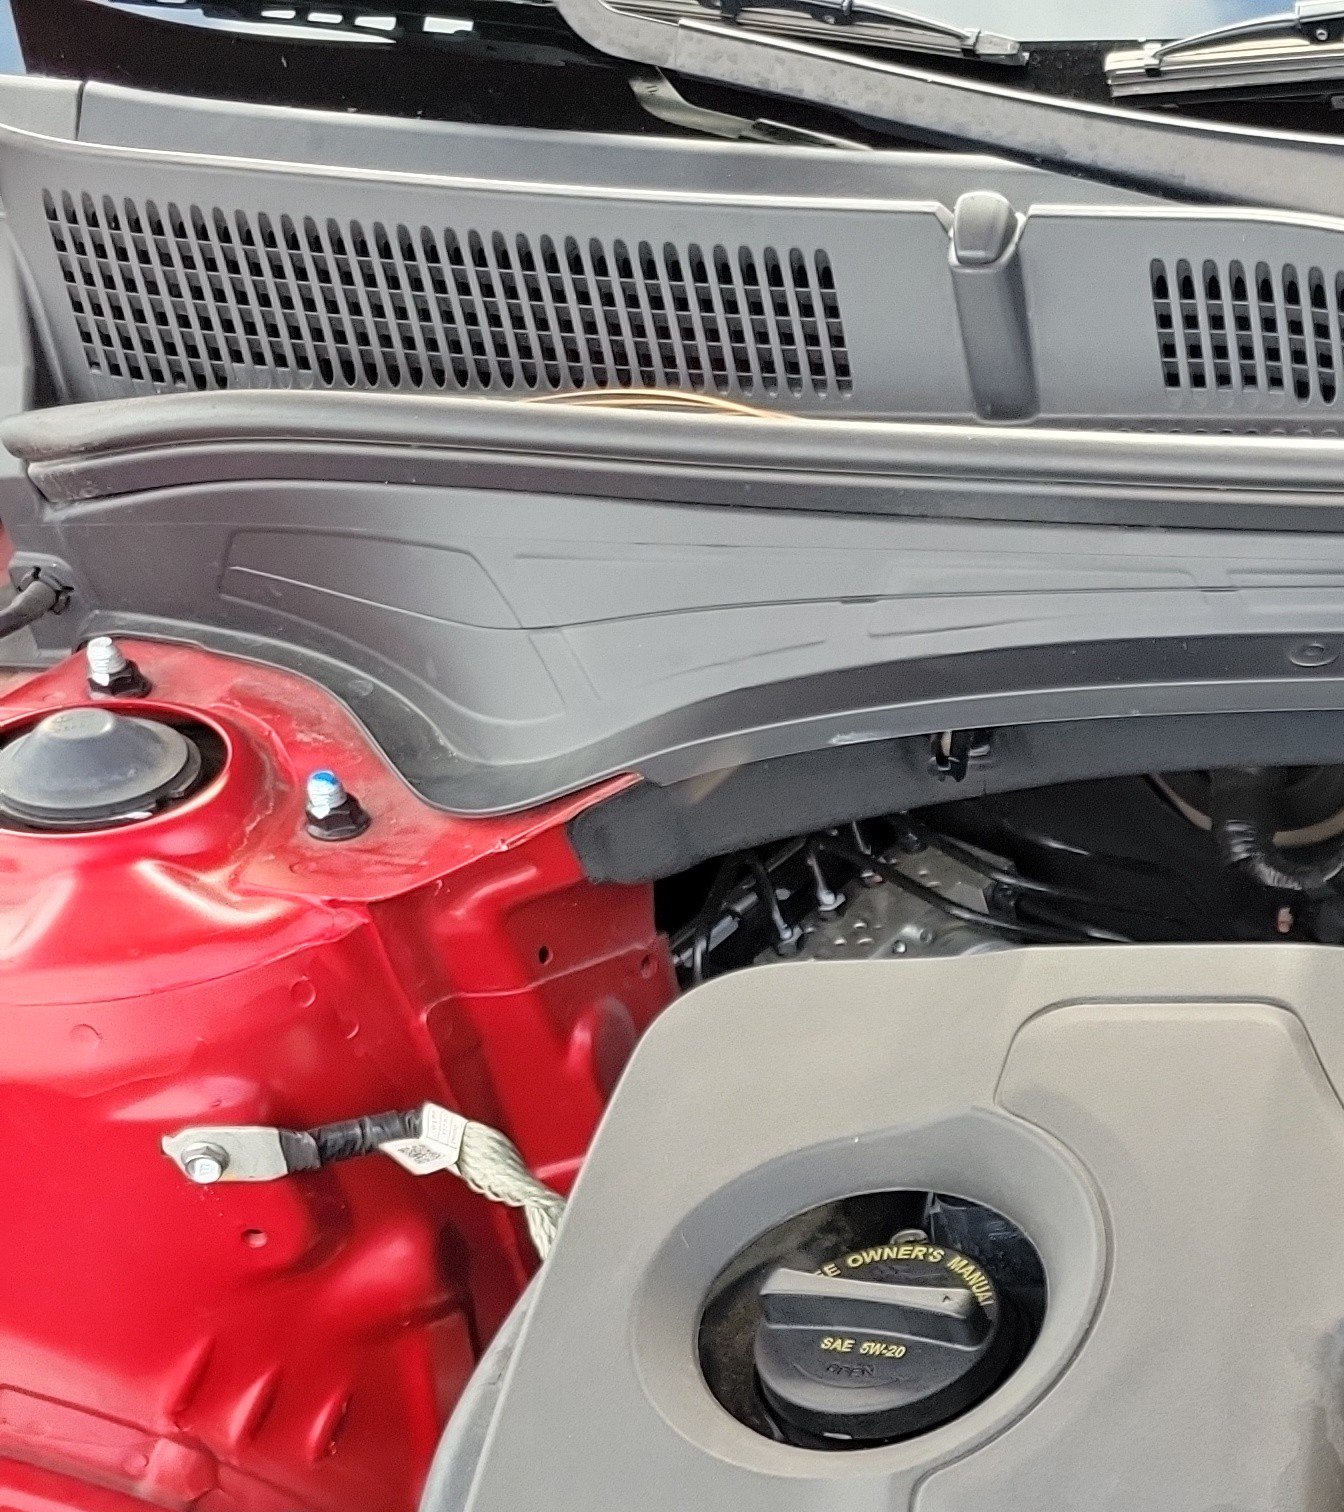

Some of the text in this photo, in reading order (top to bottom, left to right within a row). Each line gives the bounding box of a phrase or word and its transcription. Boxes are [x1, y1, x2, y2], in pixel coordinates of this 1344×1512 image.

[847, 1246, 945, 1268] OWNER'S
[820, 1336, 906, 1358] SAE 5W-20
